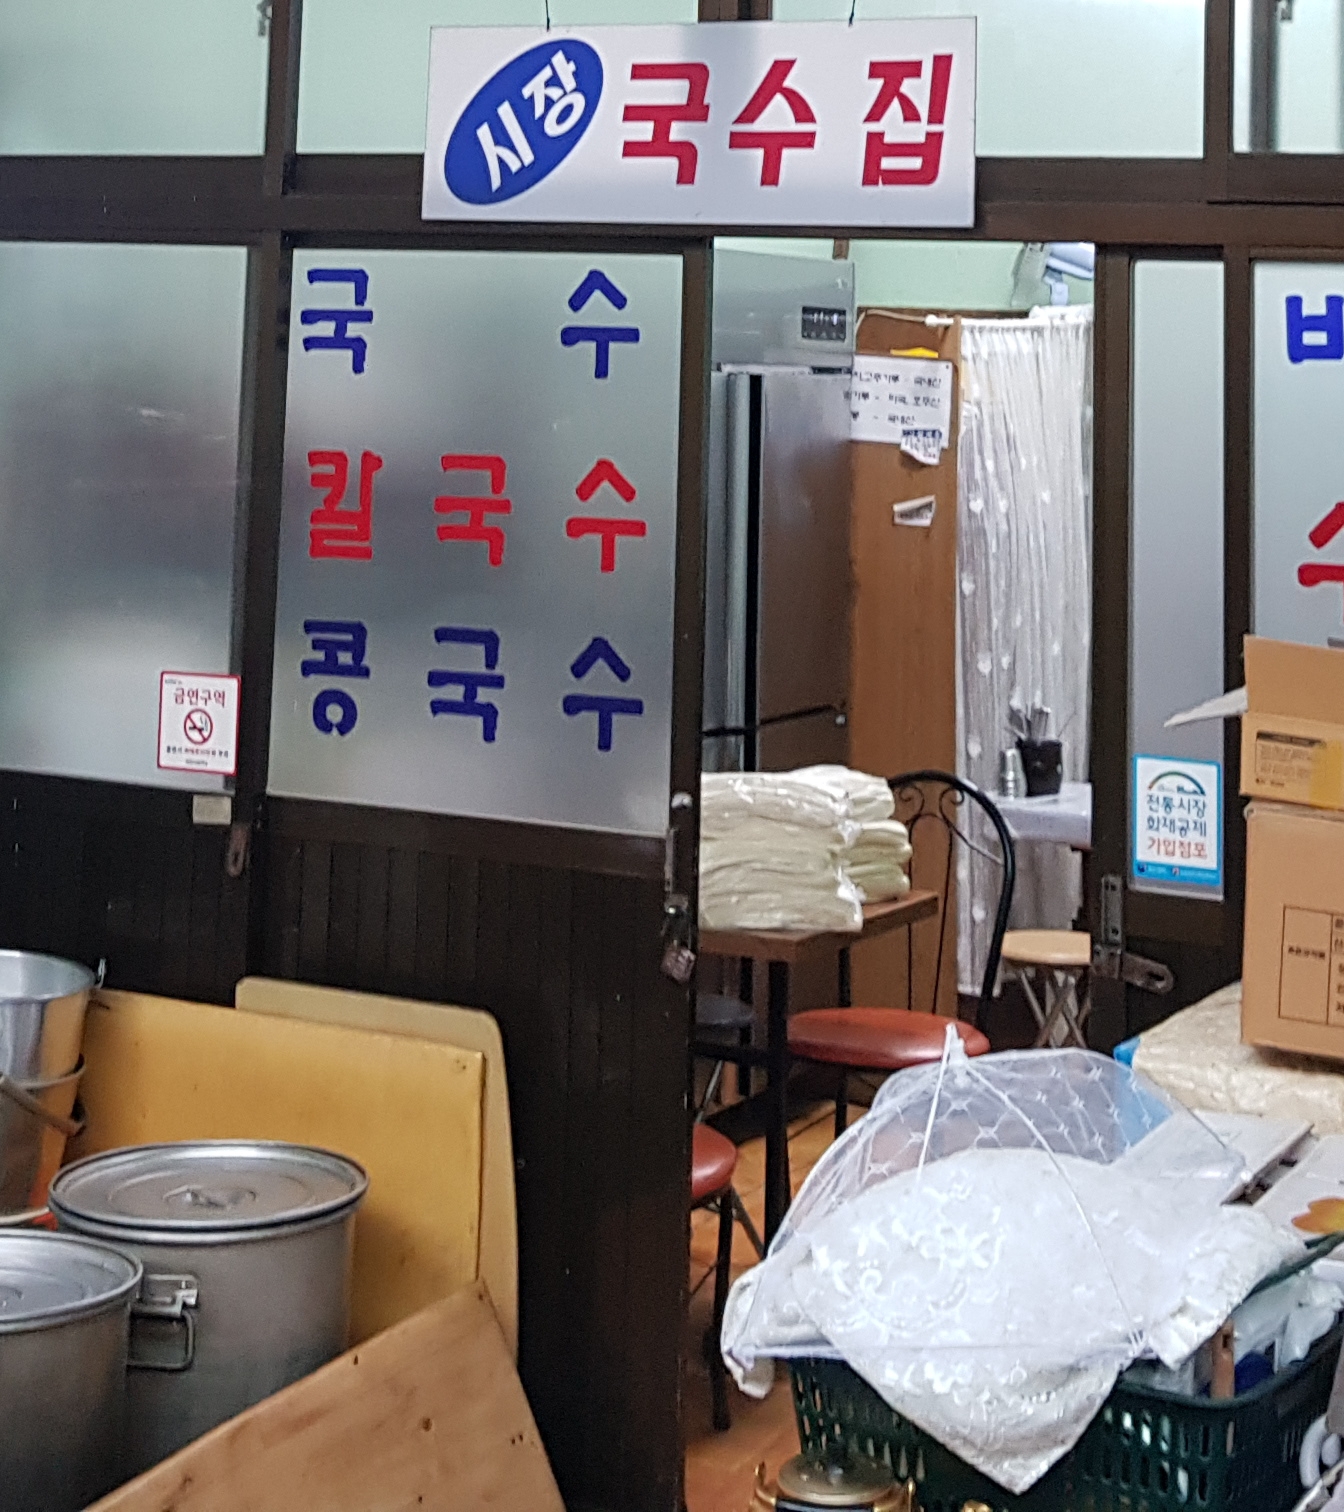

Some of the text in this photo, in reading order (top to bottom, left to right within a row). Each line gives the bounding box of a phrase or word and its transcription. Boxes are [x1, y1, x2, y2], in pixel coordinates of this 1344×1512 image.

[476, 49, 953, 192] 시장 국수집
[173, 687, 225, 708] 금연구역
[1146, 793, 1206, 819] 전통시장
[1146, 815, 1207, 838] 화재공제
[1147, 836, 1208, 859] 가입점포
